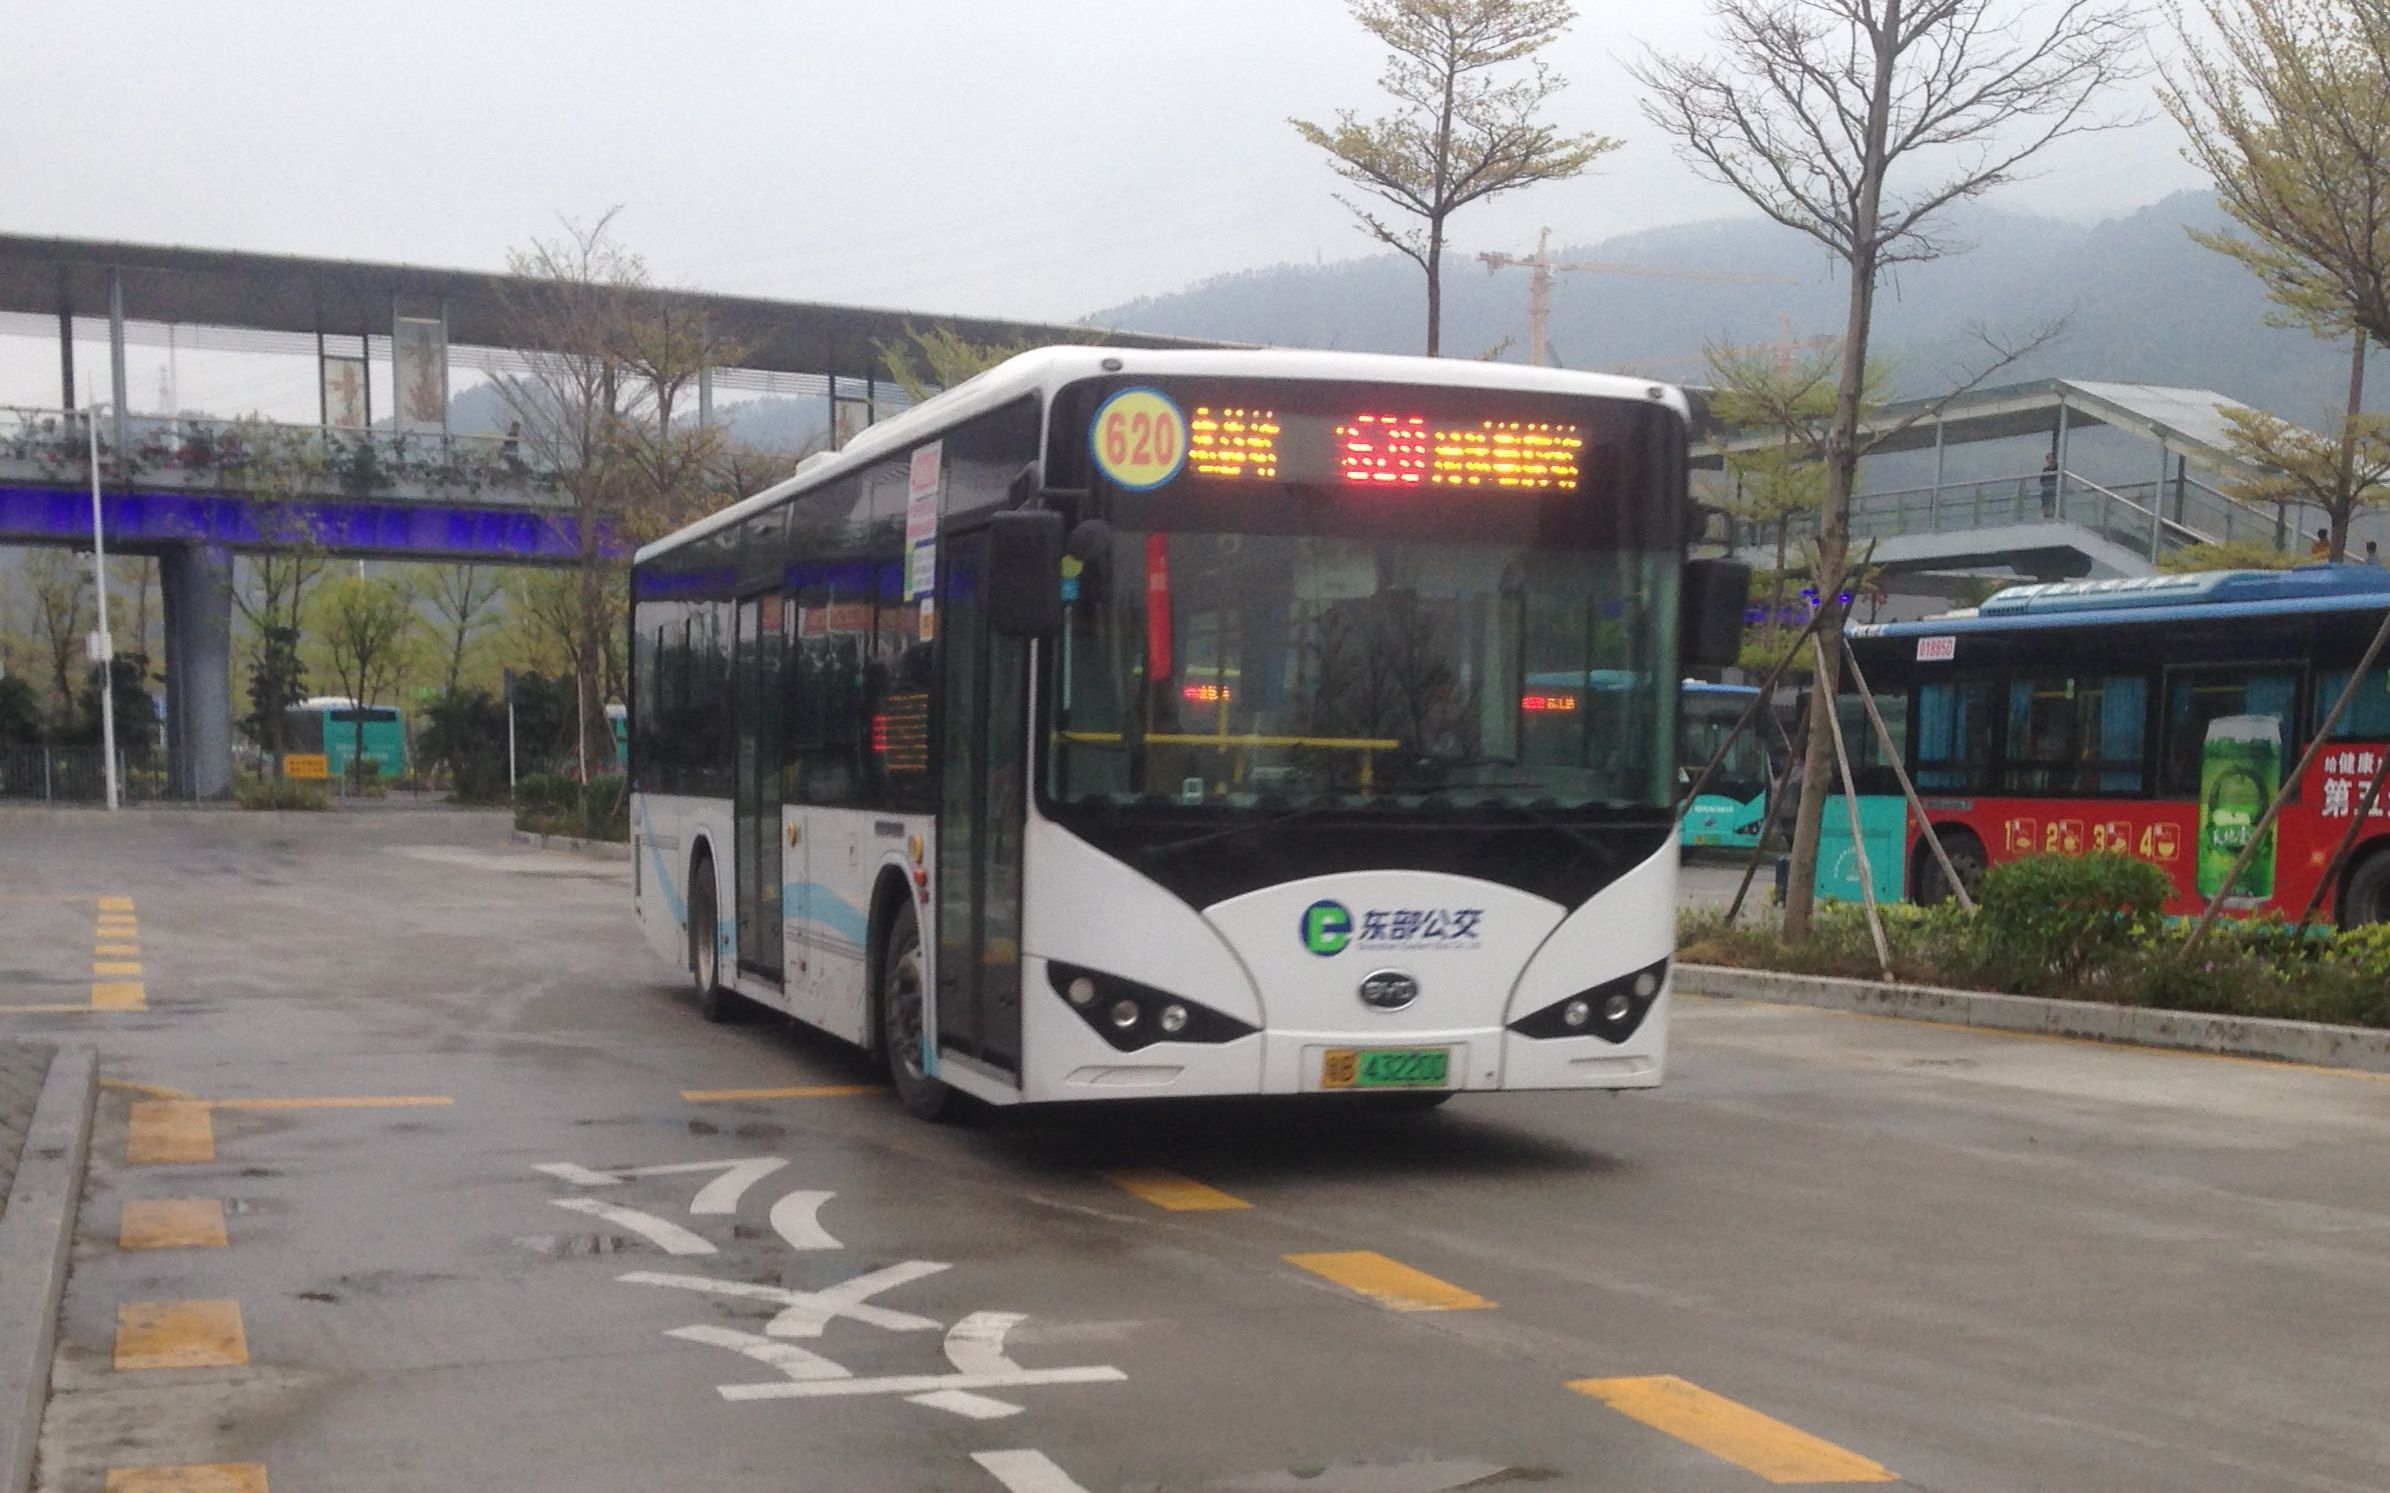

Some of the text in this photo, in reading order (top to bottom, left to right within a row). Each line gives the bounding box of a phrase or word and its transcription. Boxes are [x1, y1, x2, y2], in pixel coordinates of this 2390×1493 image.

[1105, 411, 1175, 466] 620
[2140, 825, 2152, 857] 4
[1359, 909, 1484, 941] 东部公交
